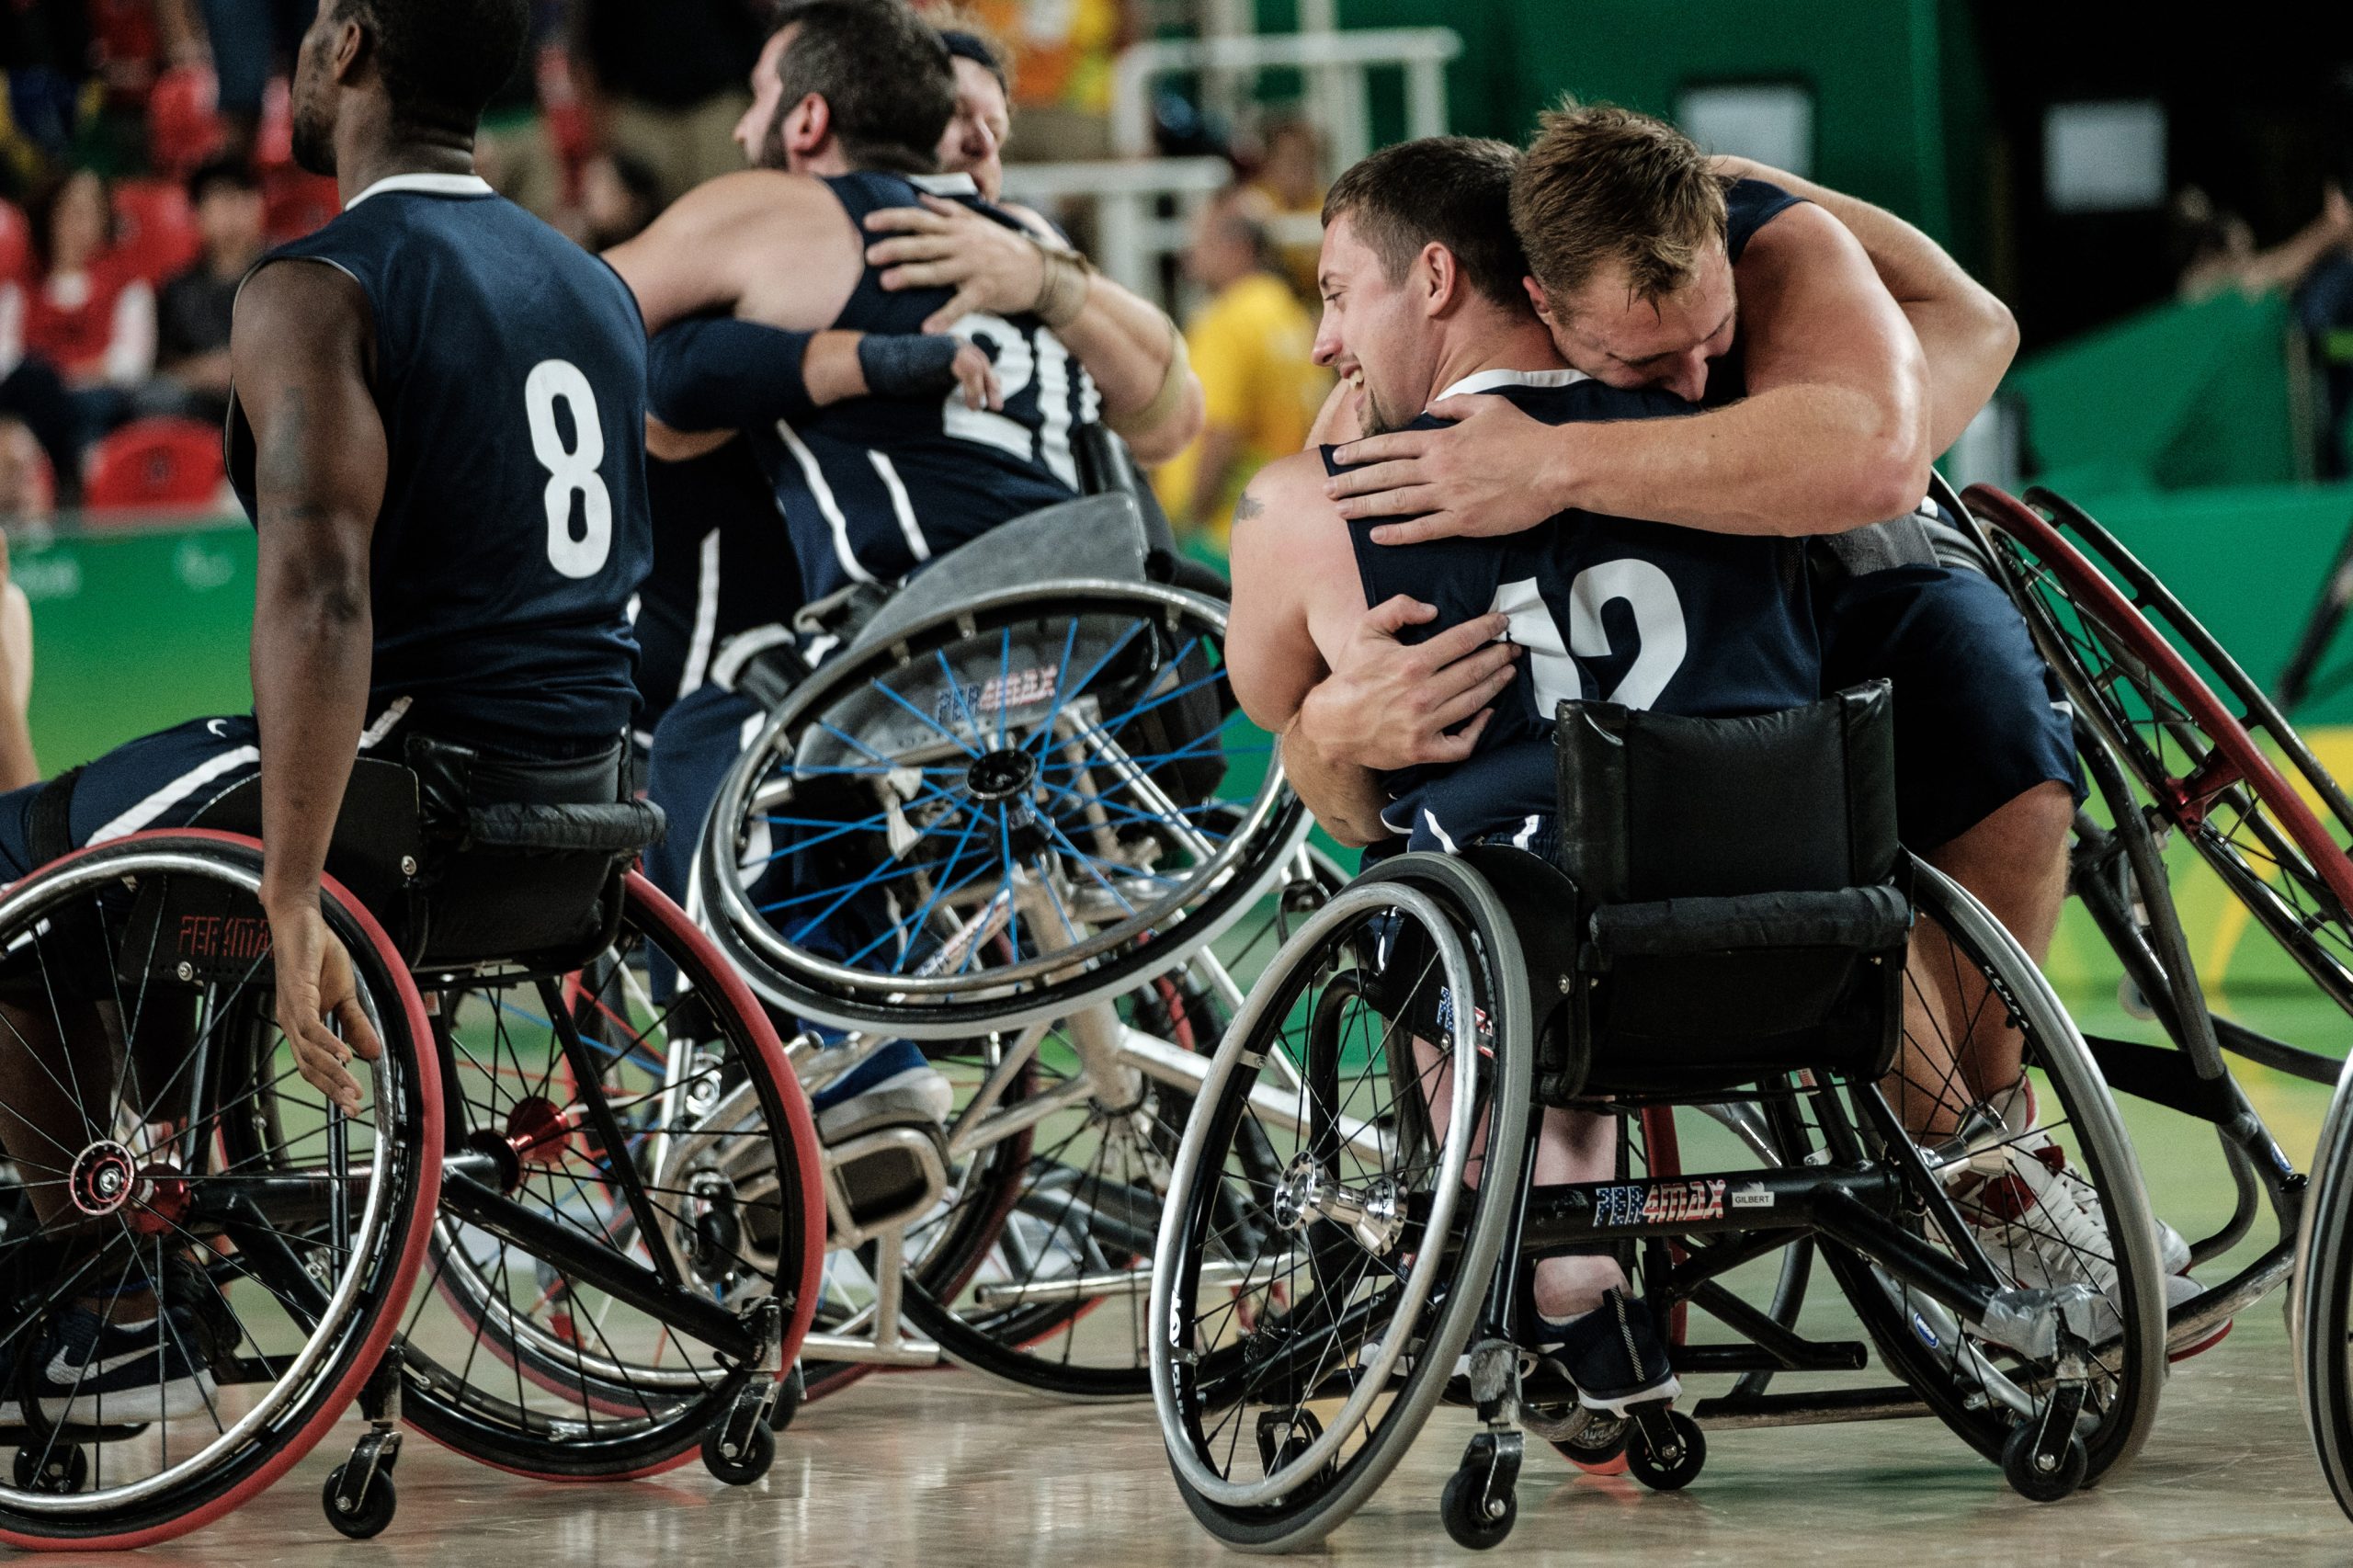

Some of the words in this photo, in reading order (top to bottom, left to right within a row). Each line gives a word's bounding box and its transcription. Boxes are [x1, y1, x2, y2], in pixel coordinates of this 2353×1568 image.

[525, 358, 613, 579] 8
[1486, 558, 1688, 722] 12
[1592, 1178, 1727, 1228] PER4MAX
[1734, 1195, 1770, 1205] GILBERT
